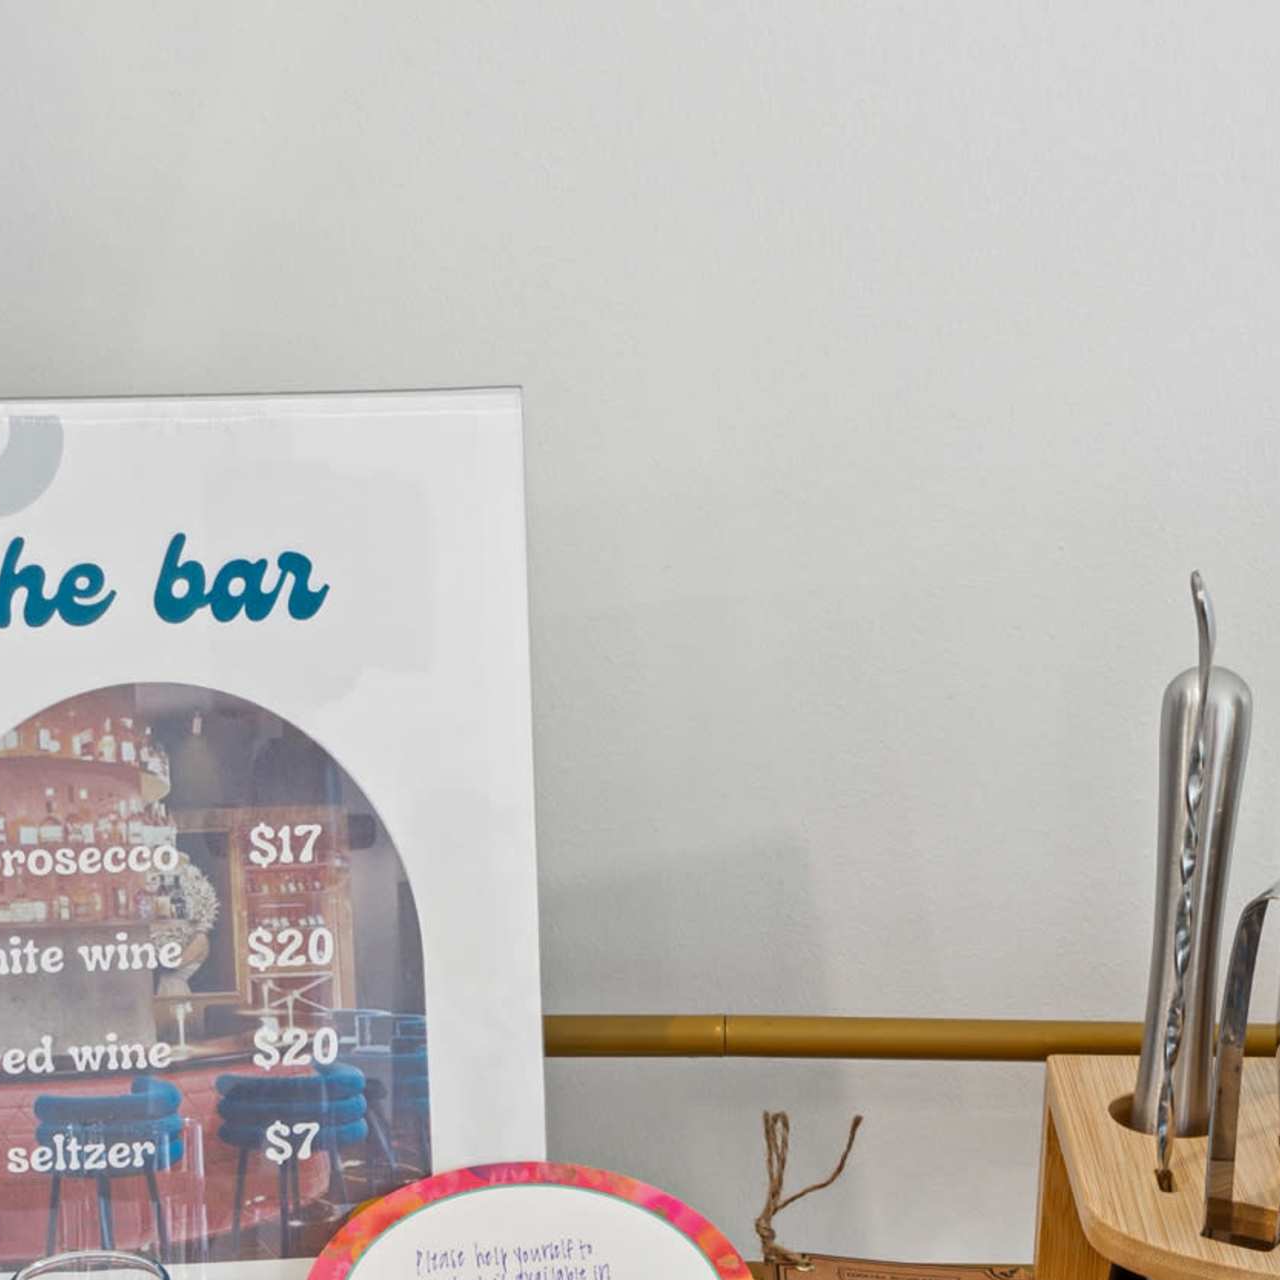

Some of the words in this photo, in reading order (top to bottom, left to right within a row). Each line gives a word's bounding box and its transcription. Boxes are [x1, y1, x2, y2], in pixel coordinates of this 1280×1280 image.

[154, 532, 330, 623] bar
[249, 822, 322, 868] $17
[79, 932, 183, 971] wine
[247, 927, 335, 971] $20
[69, 1031, 173, 1071] wine
[252, 1025, 339, 1070] $20
[7, 1136, 155, 1174] seltzer
[265, 1121, 320, 1165] $7
[415, 1249, 465, 1276] Please
[474, 1241, 508, 1272] help
[513, 1238, 574, 1266] yourself
[579, 1240, 593, 1260] to
